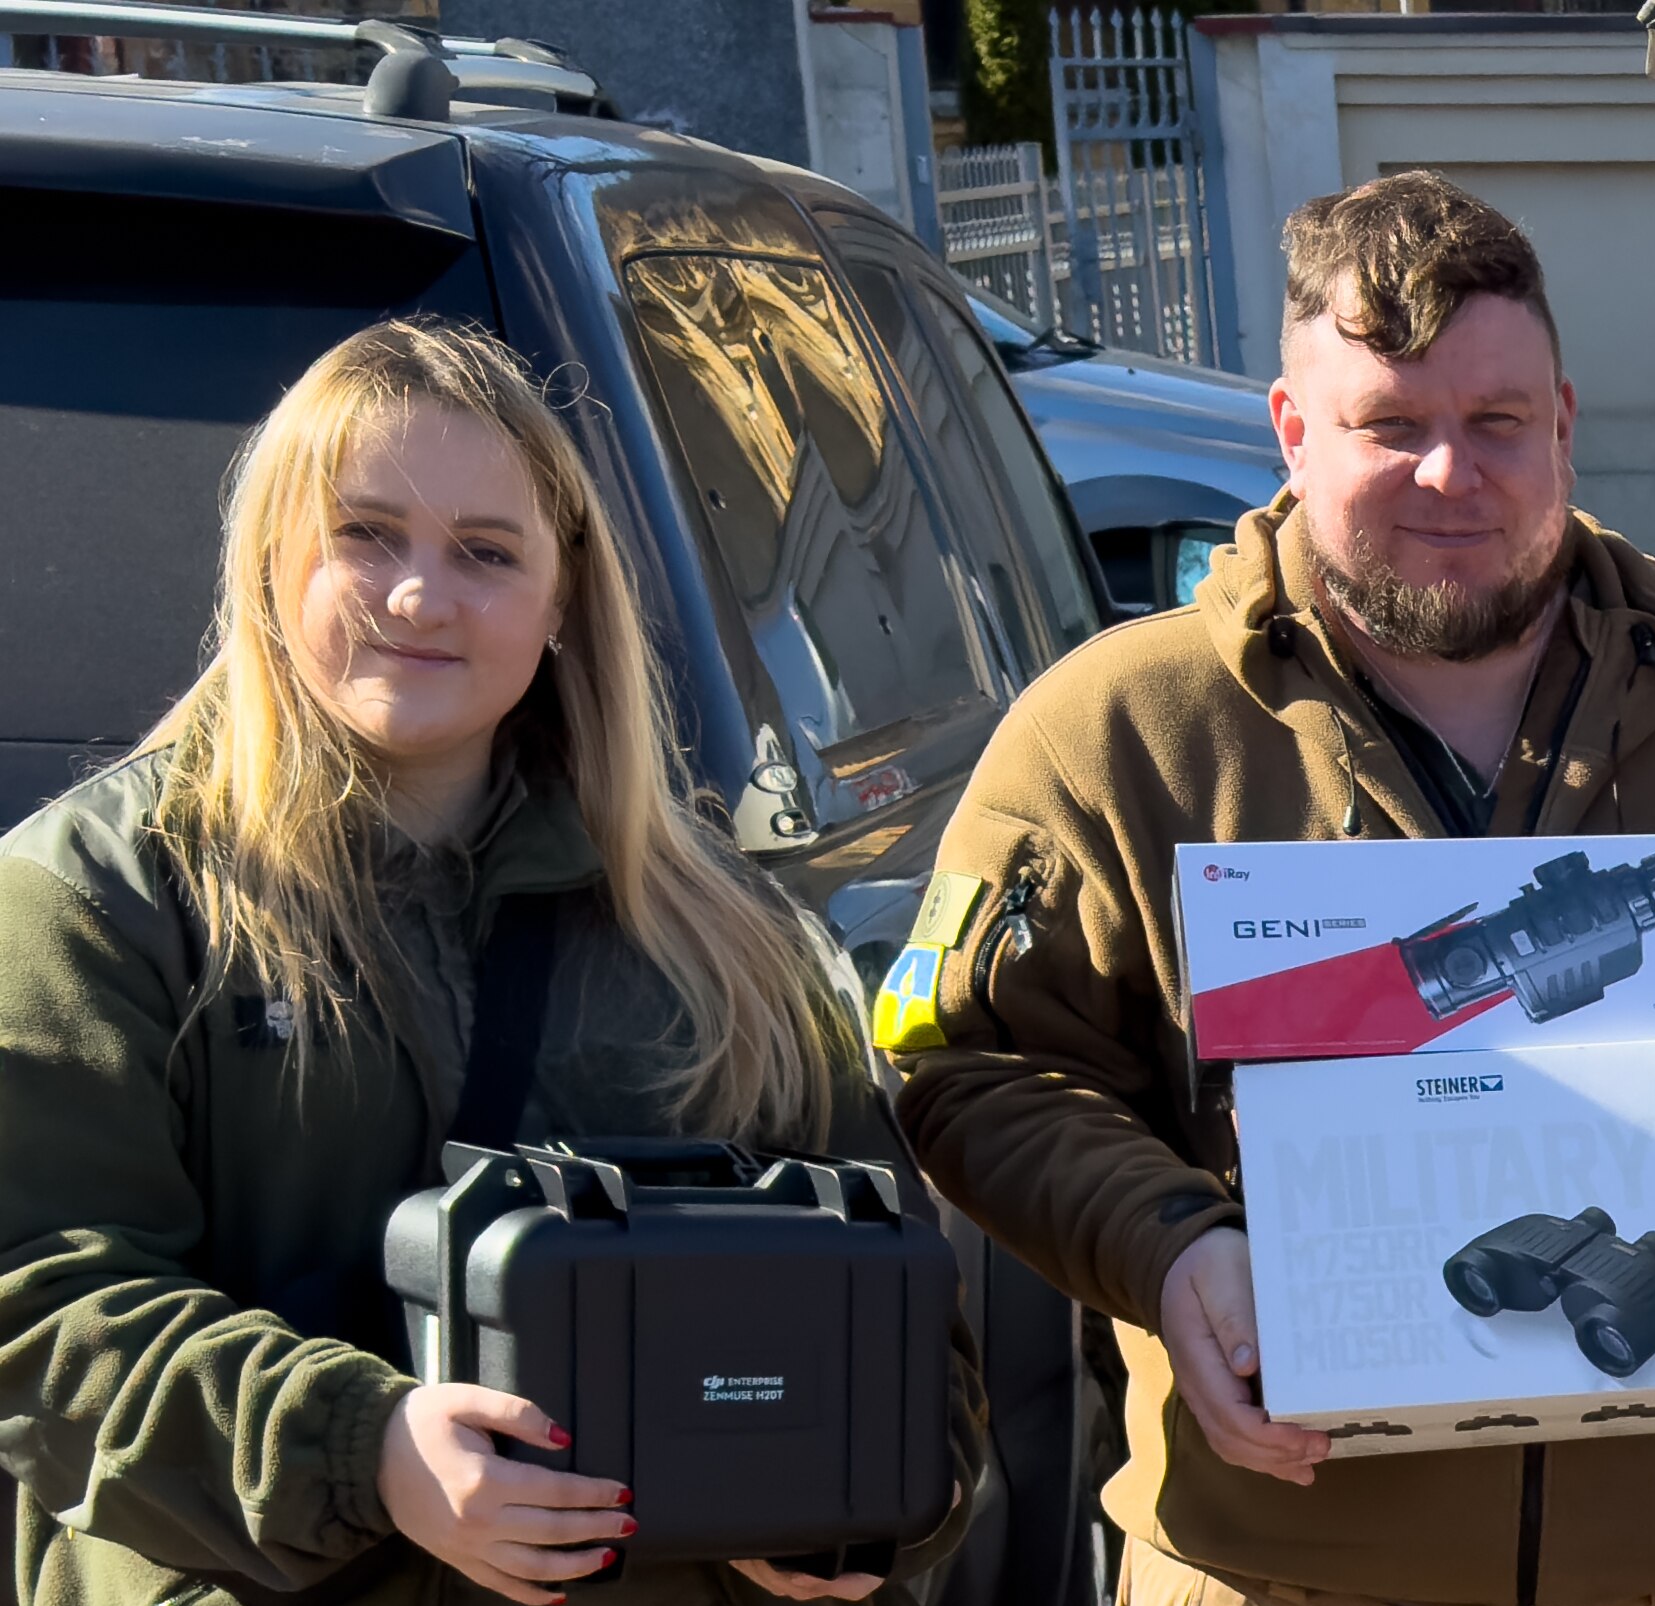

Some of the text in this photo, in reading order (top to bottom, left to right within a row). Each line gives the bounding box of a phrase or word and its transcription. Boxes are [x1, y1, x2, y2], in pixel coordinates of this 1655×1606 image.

[1233, 919, 1321, 939] GENI
[1416, 1076, 1480, 1096] STEINER
[1273, 1117, 1651, 1238] MILITARY
[1288, 1275, 1430, 1328] M750R
[1293, 1321, 1450, 1375] M1050R
[727, 1376, 784, 1386] ENTERPRISE
[703, 1390, 784, 1401] ZENMUSE H20T
